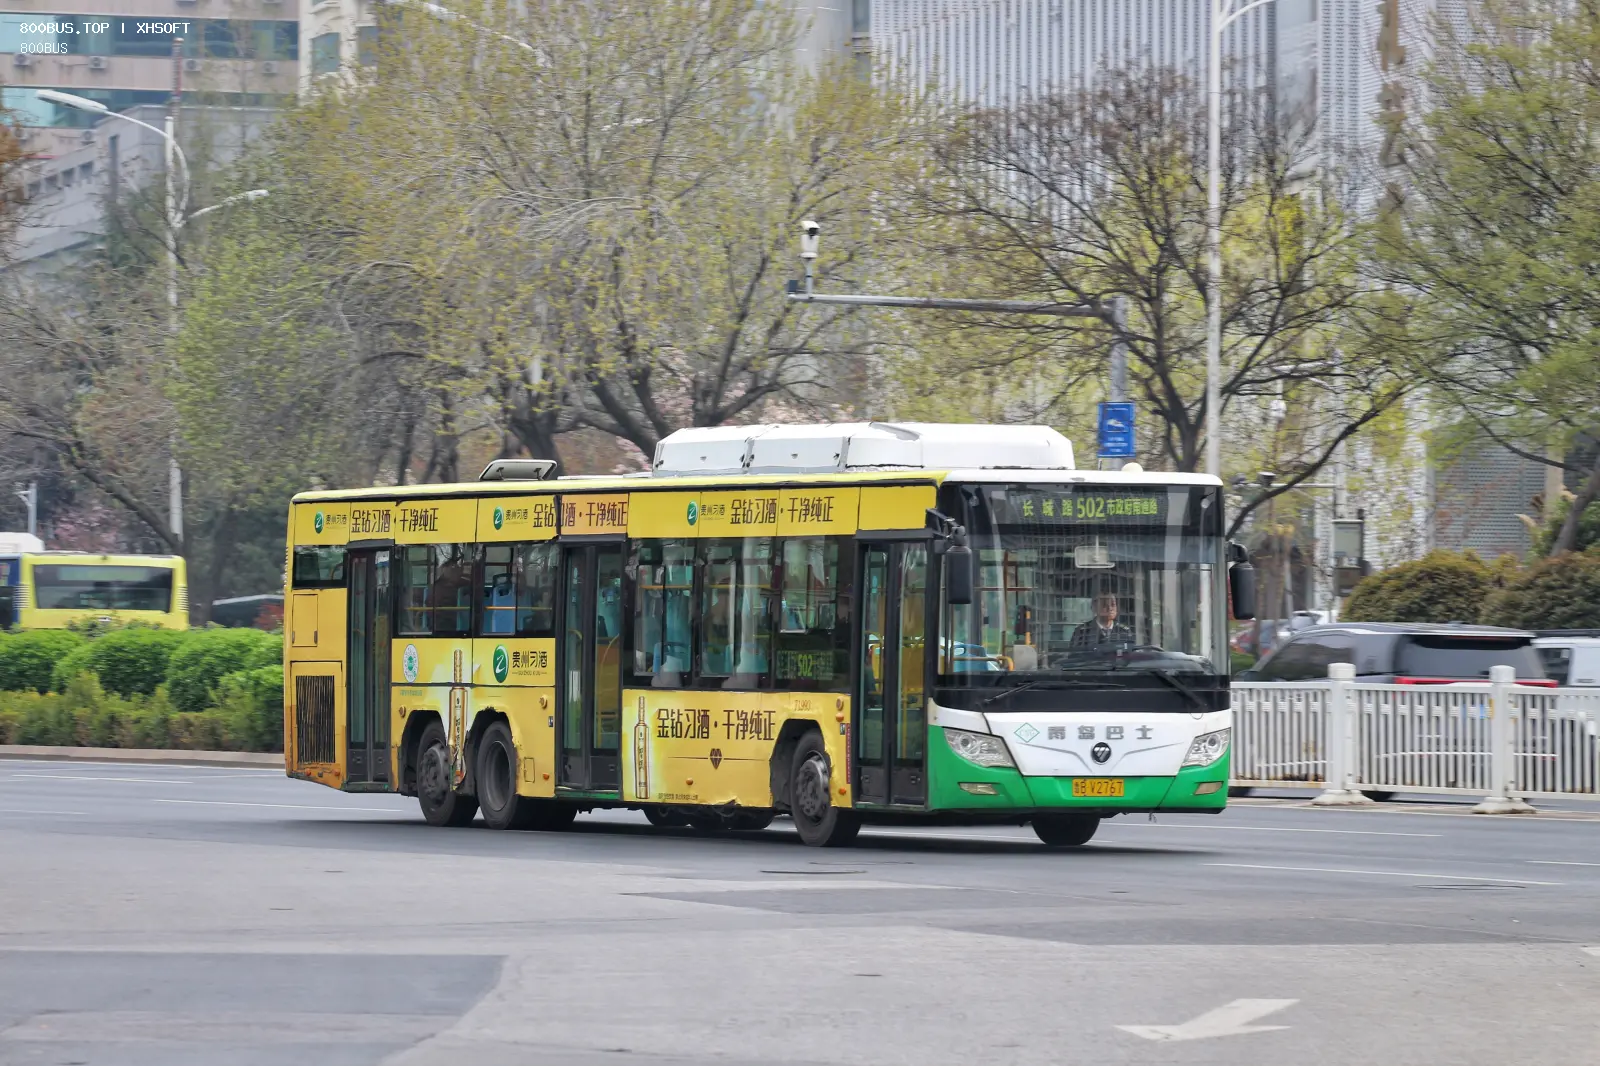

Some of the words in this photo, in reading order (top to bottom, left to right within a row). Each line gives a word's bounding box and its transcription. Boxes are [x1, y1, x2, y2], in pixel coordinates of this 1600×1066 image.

[1076, 497, 1105, 518] 502
[512, 650, 547, 668] 贵州习酒
[797, 654, 813, 677] 502
